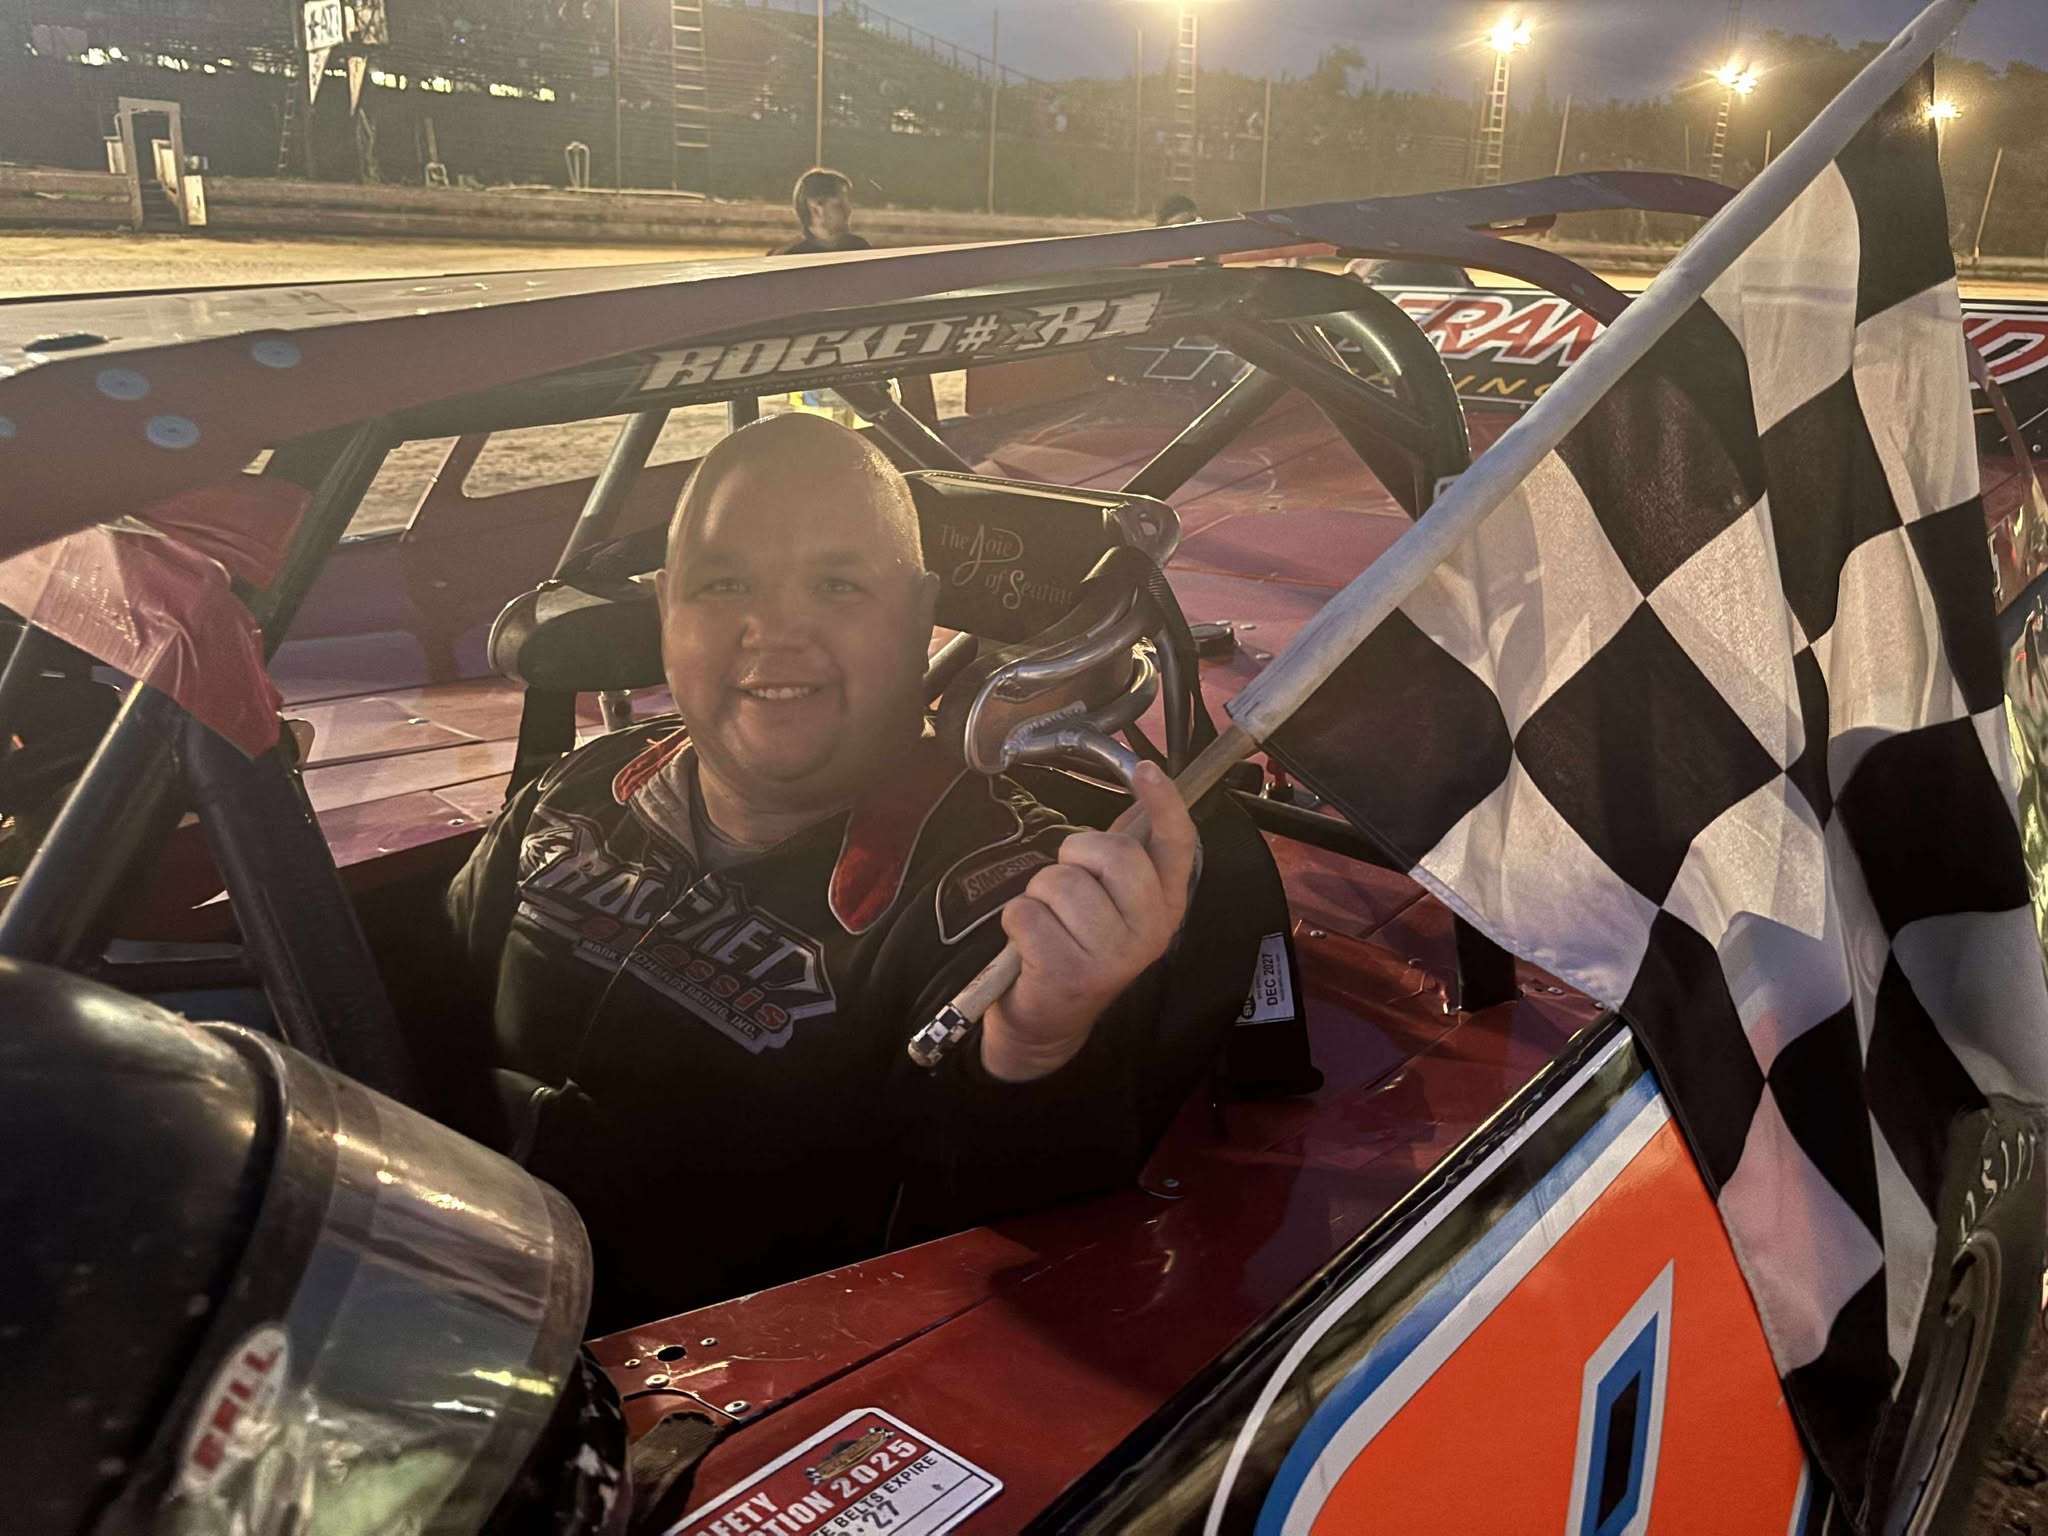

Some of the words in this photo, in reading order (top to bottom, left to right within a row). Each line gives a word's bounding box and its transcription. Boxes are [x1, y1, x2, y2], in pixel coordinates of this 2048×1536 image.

[1264, 978, 1279, 1007] DEC
[831, 1438, 918, 1499] 2025
[836, 1491, 885, 1530] BELTS
[882, 1454, 938, 1495] EXPIRE
